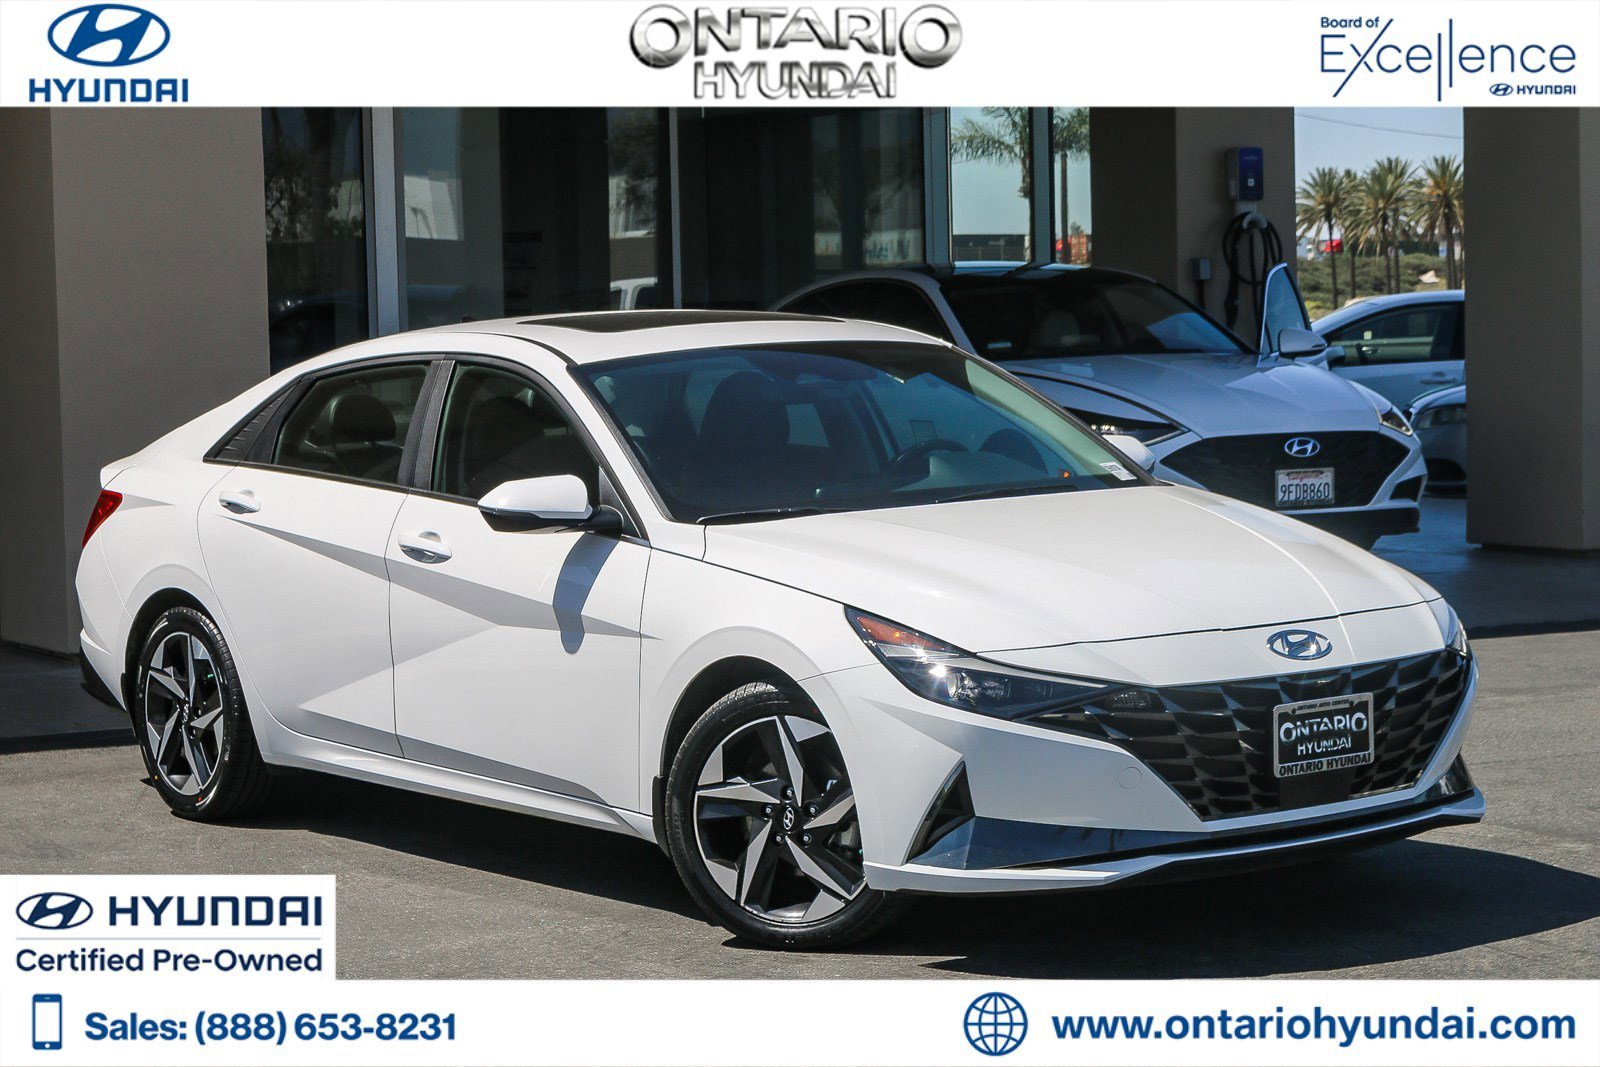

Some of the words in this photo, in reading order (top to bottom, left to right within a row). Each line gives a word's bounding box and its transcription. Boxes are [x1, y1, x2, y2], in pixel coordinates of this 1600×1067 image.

[1280, 483, 1330, 501] 9FDB860
[1280, 712, 1368, 742] ONTARIO
[1297, 735, 1351, 755] HYUNDAI
[1279, 760, 1324, 776] ONTARIO
[1327, 752, 1371, 769] HYUNDAI
